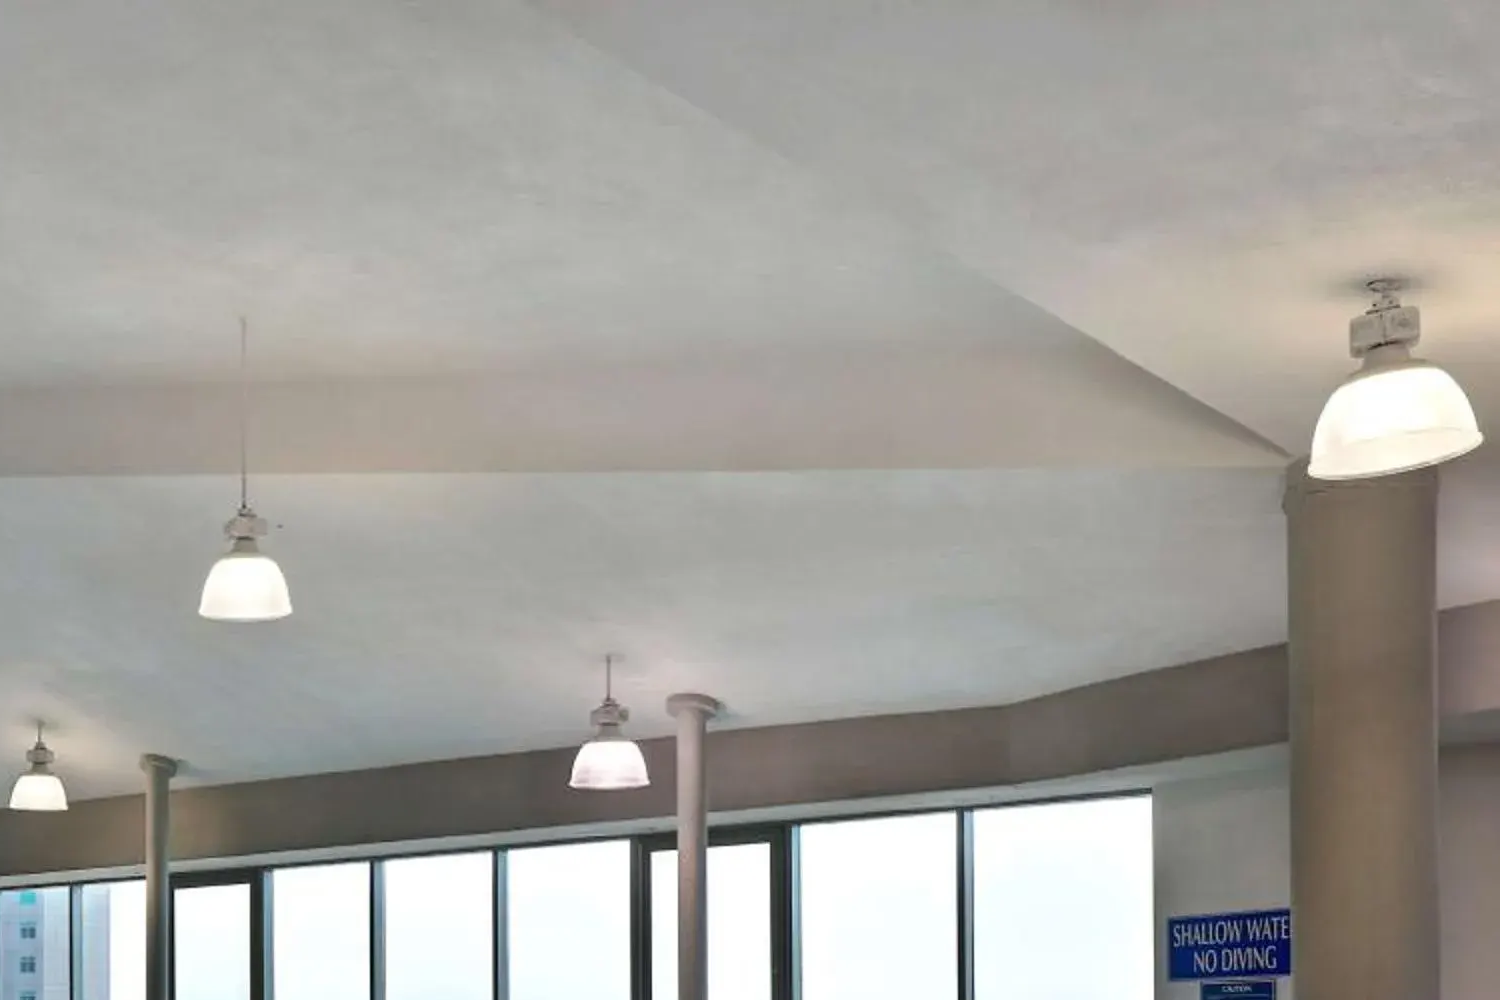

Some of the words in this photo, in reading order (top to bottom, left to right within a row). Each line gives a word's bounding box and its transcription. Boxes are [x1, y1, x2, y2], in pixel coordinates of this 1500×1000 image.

[1173, 920, 1243, 948] SHALLOW
[1246, 916, 1289, 941] WATE
[1193, 950, 1217, 974] NO
[1221, 945, 1277, 972] DIVING
